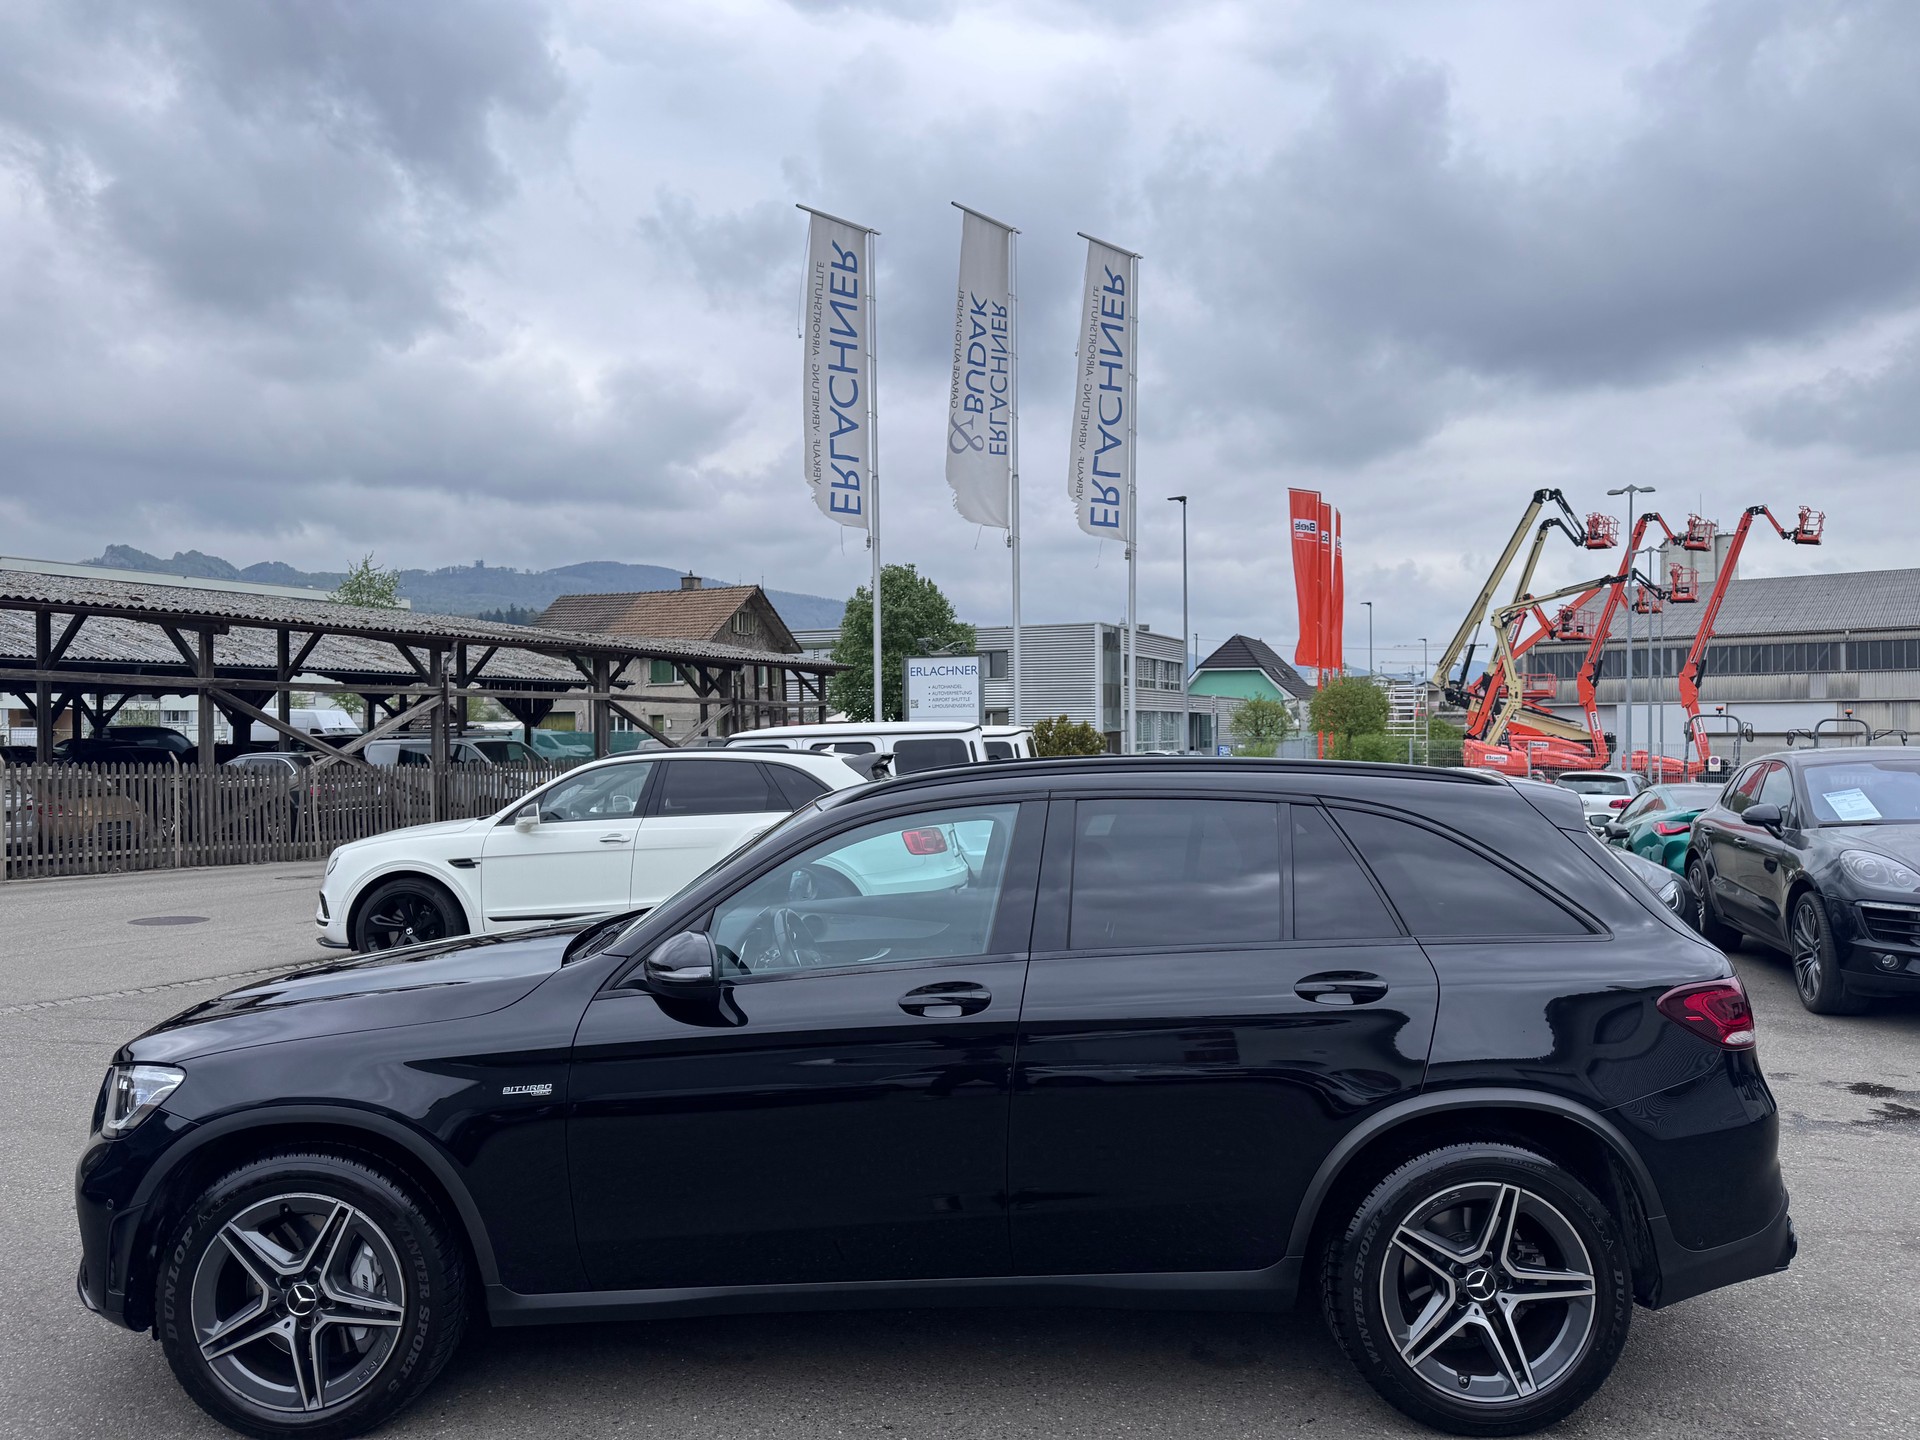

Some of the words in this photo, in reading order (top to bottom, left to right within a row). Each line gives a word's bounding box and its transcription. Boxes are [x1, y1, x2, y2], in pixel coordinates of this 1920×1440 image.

[910, 665, 978, 677] ERLACHNER
[502, 1083, 553, 1093] BITURBO
[165, 1226, 194, 1341] DUNLOP
[395, 1216, 430, 1298] WINTER
[1354, 1215, 1384, 1283] SPORT
[400, 1305, 431, 1379] SPORT
[1353, 1287, 1381, 1366] WINTER
[1602, 1268, 1625, 1364] DUNLO
